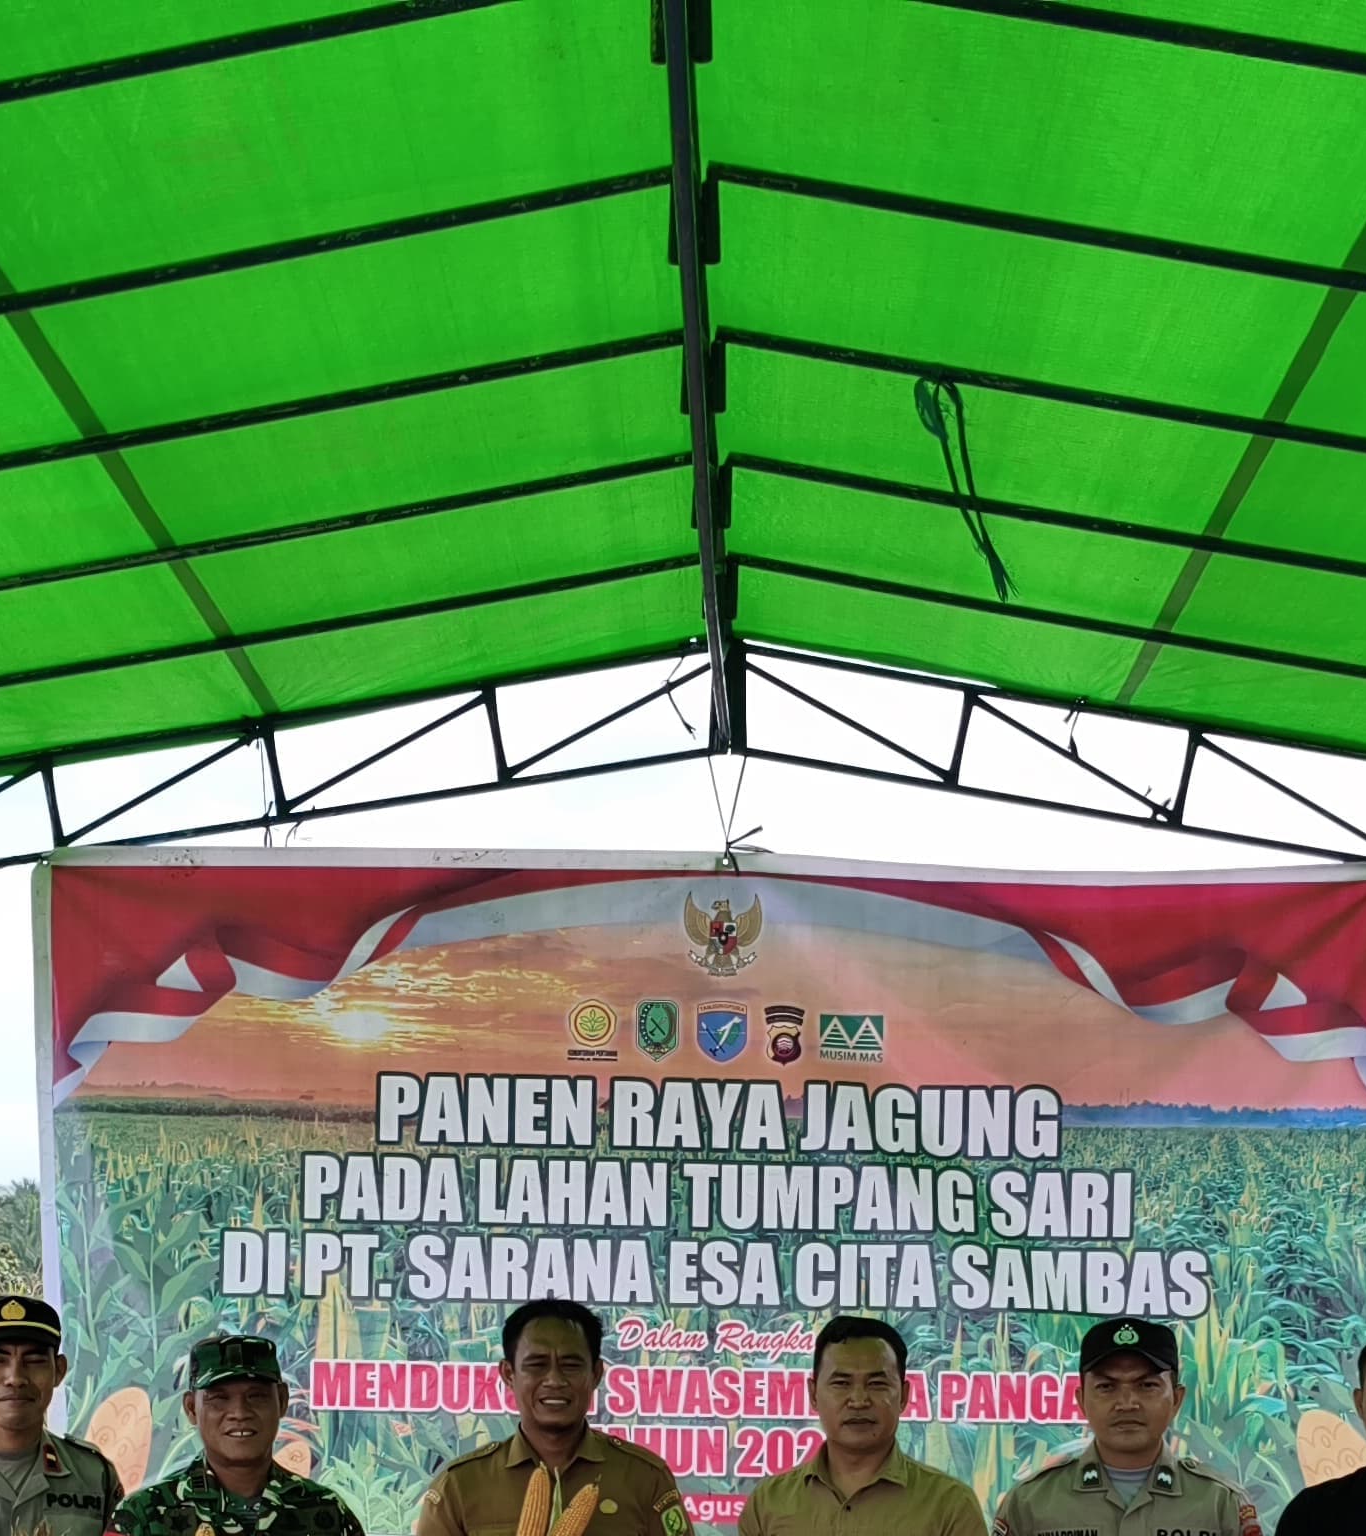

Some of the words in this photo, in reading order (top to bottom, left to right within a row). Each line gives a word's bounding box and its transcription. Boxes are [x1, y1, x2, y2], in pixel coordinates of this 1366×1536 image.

[819, 1049, 857, 1061] MUSIM
[859, 1052, 884, 1063] MAS
[377, 1073, 596, 1147] PANEN
[611, 1078, 788, 1152] RAYA
[798, 1082, 1061, 1160] JAGUNG
[302, 1153, 465, 1224] PADA
[477, 1156, 669, 1228] LAHAN
[682, 1161, 977, 1234] TUMPANG
[989, 1169, 1133, 1240] SARI
[221, 1229, 289, 1297] DI
[303, 1231, 394, 1299] PT.
[406, 1234, 655, 1303] SARANA
[668, 1239, 781, 1307] ESA
[794, 1240, 938, 1309] CITA
[949, 1244, 1211, 1318] SAMBAS
[616, 1317, 708, 1351] Dalam
[716, 1320, 816, 1361] Rangka
[311, 1360, 597, 1415] MENDUK
[605, 1366, 933, 1421] SWASEMA
[938, 1371, 1089, 1424] PANGA
[735, 1428, 827, 1477] 202
[46, 1492, 101, 1510] POLRI
[684, 1496, 745, 1521] Agus
